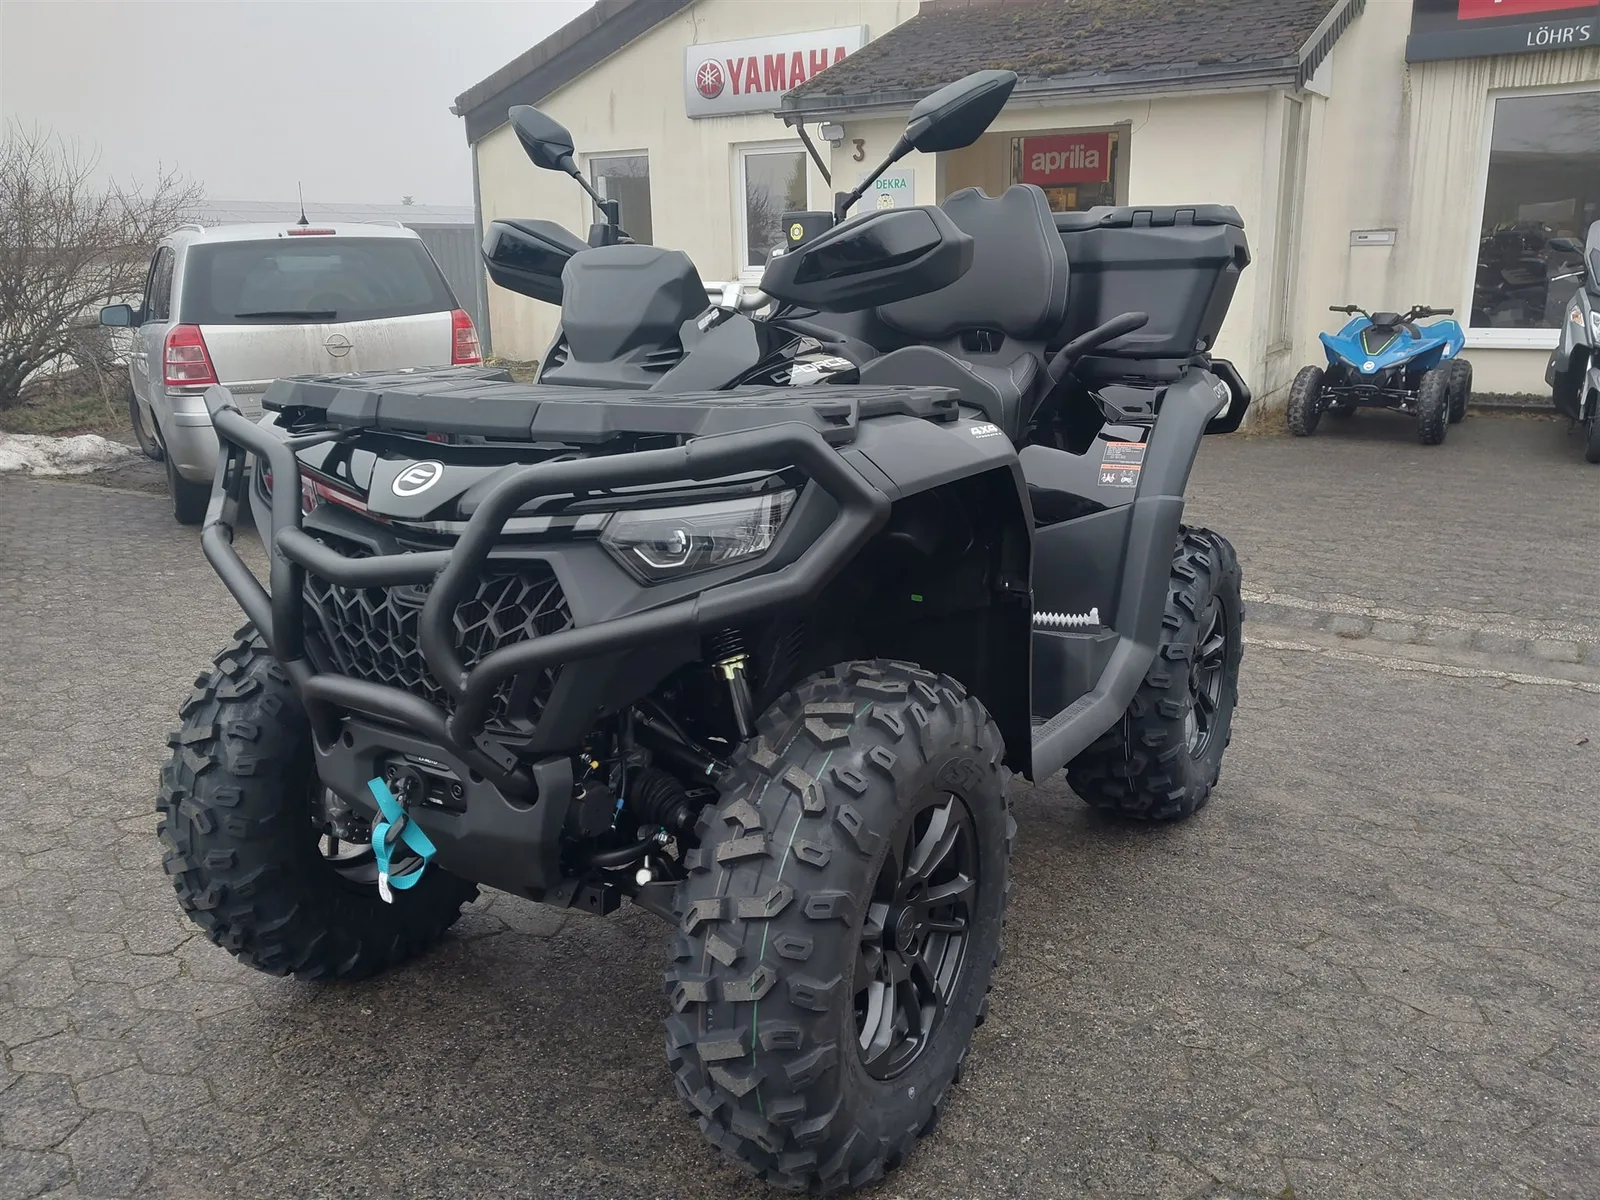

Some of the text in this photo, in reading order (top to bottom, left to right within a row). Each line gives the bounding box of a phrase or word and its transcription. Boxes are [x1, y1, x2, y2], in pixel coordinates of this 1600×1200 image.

[852, 139, 865, 161] 3
[1031, 144, 1100, 175] aprilia
[876, 178, 907, 189] DEKRA
[697, 307, 720, 330] EPS
